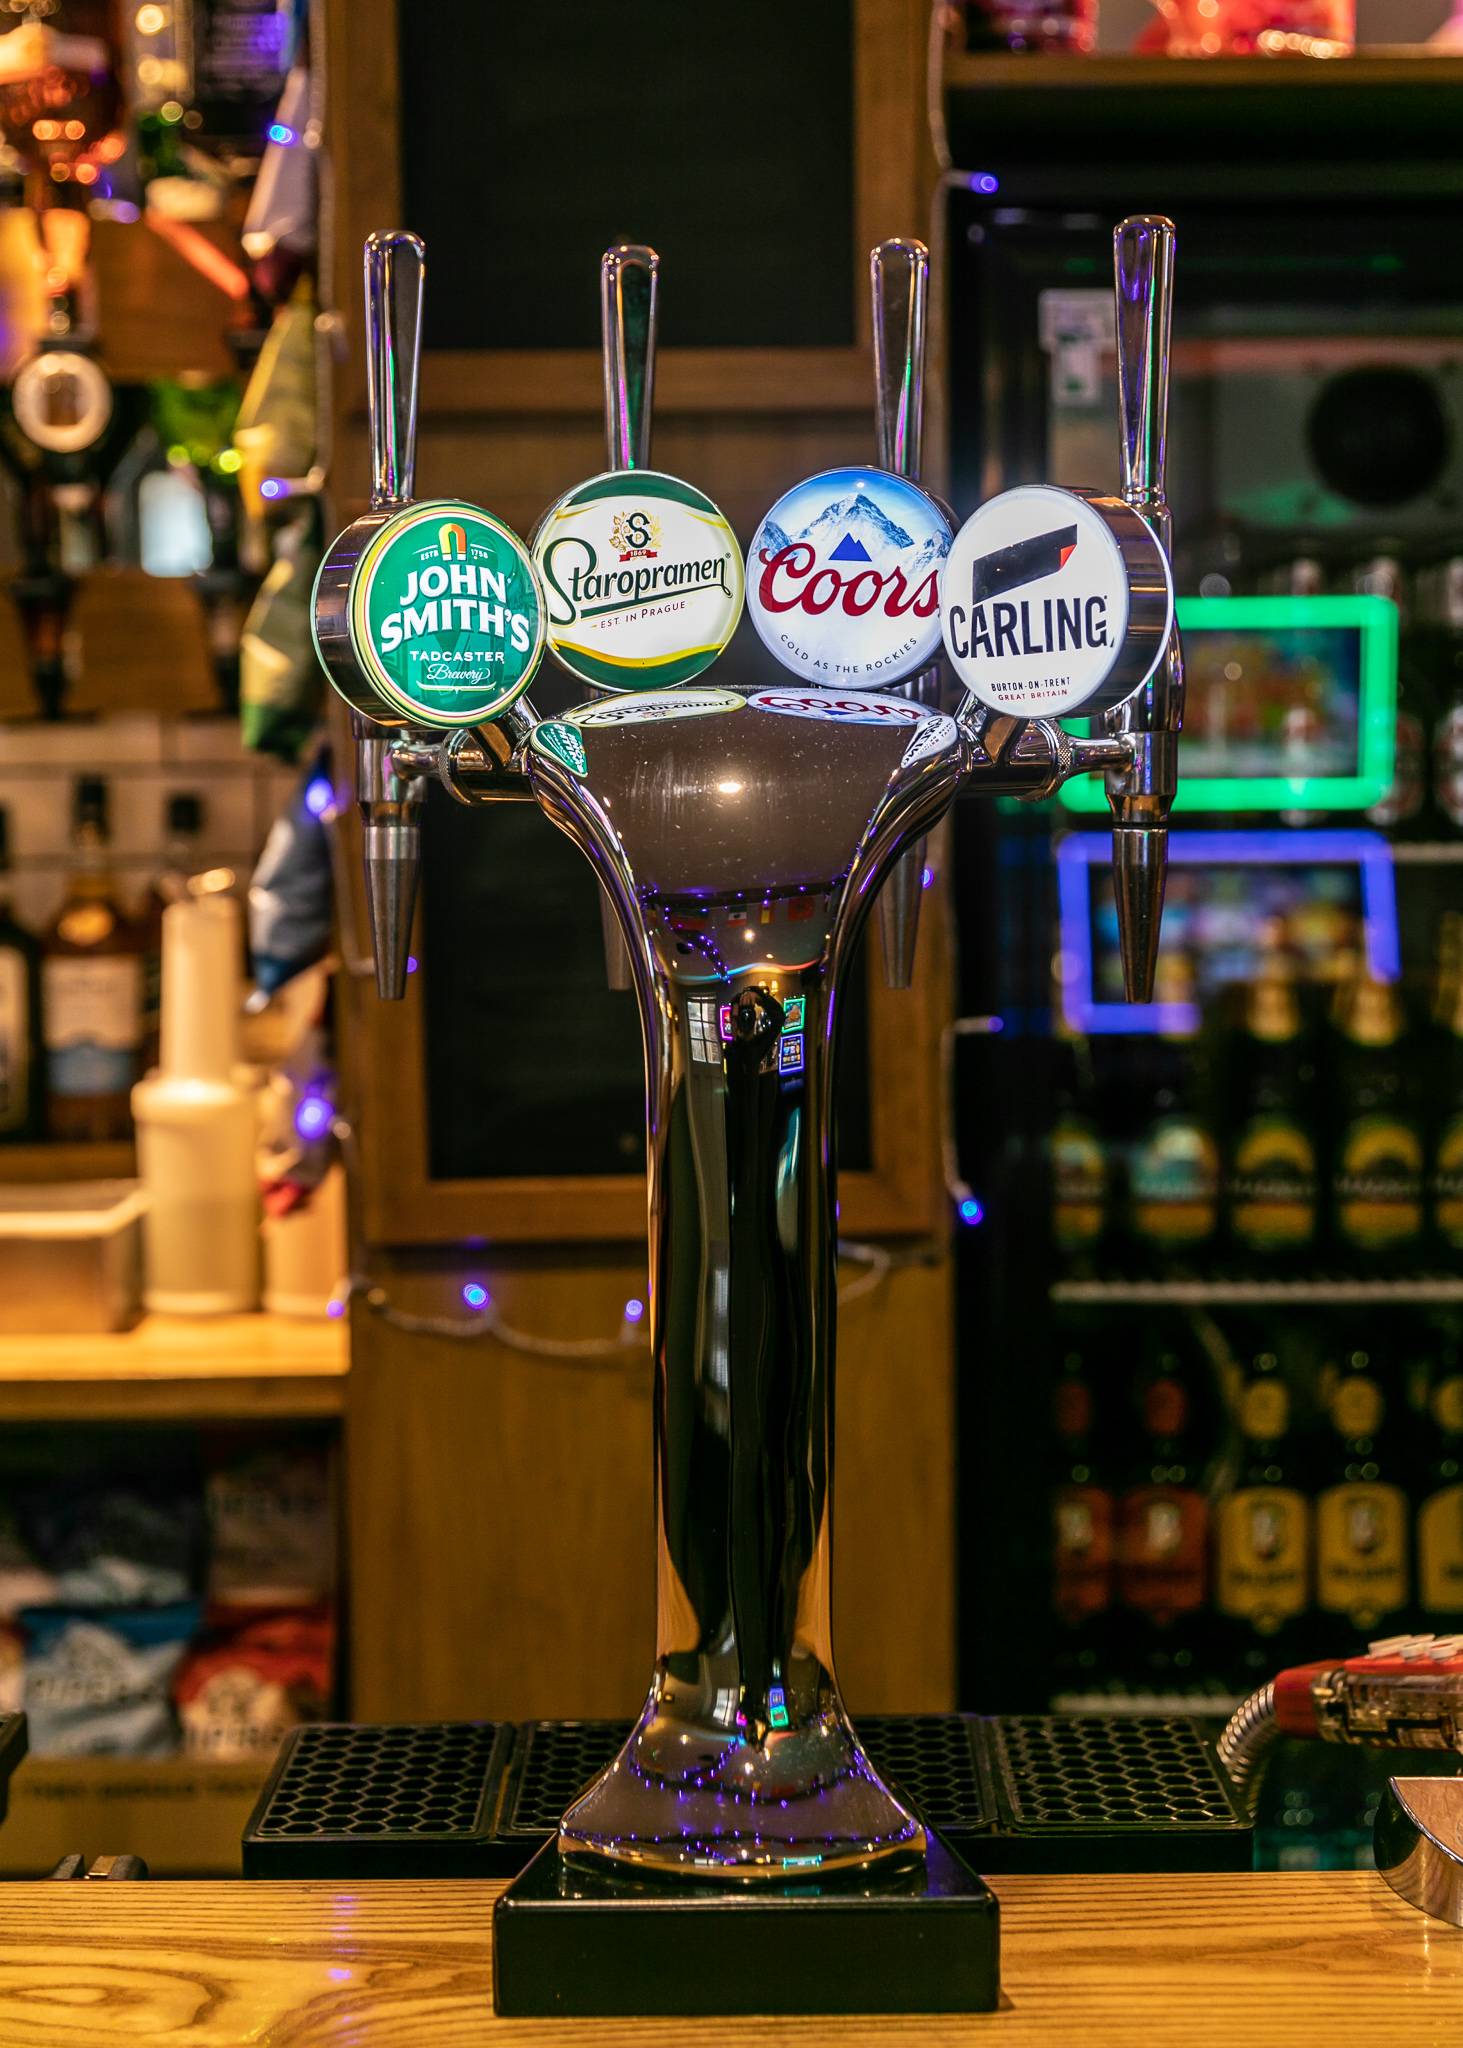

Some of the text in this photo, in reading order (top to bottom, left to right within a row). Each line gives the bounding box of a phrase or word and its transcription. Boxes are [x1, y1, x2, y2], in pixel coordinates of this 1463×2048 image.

[400, 564, 507, 606] JOHN
[543, 537, 733, 625] Staropramen
[758, 542, 940, 618] Coors
[380, 599, 530, 654] SMITH'S
[625, 612, 637, 623] IN
[641, 601, 686, 619] PRAGUE
[949, 595, 1108, 659] CARLING
[409, 650, 505, 662] TADCASTER
[780, 634, 917, 673] COLD AS THE ROCKIES
[426, 663, 491, 685] Brewery
[991, 677, 1071, 692] BURTON-ON-TRENT
[998, 689, 1068, 701] GREAT BRITAIN
